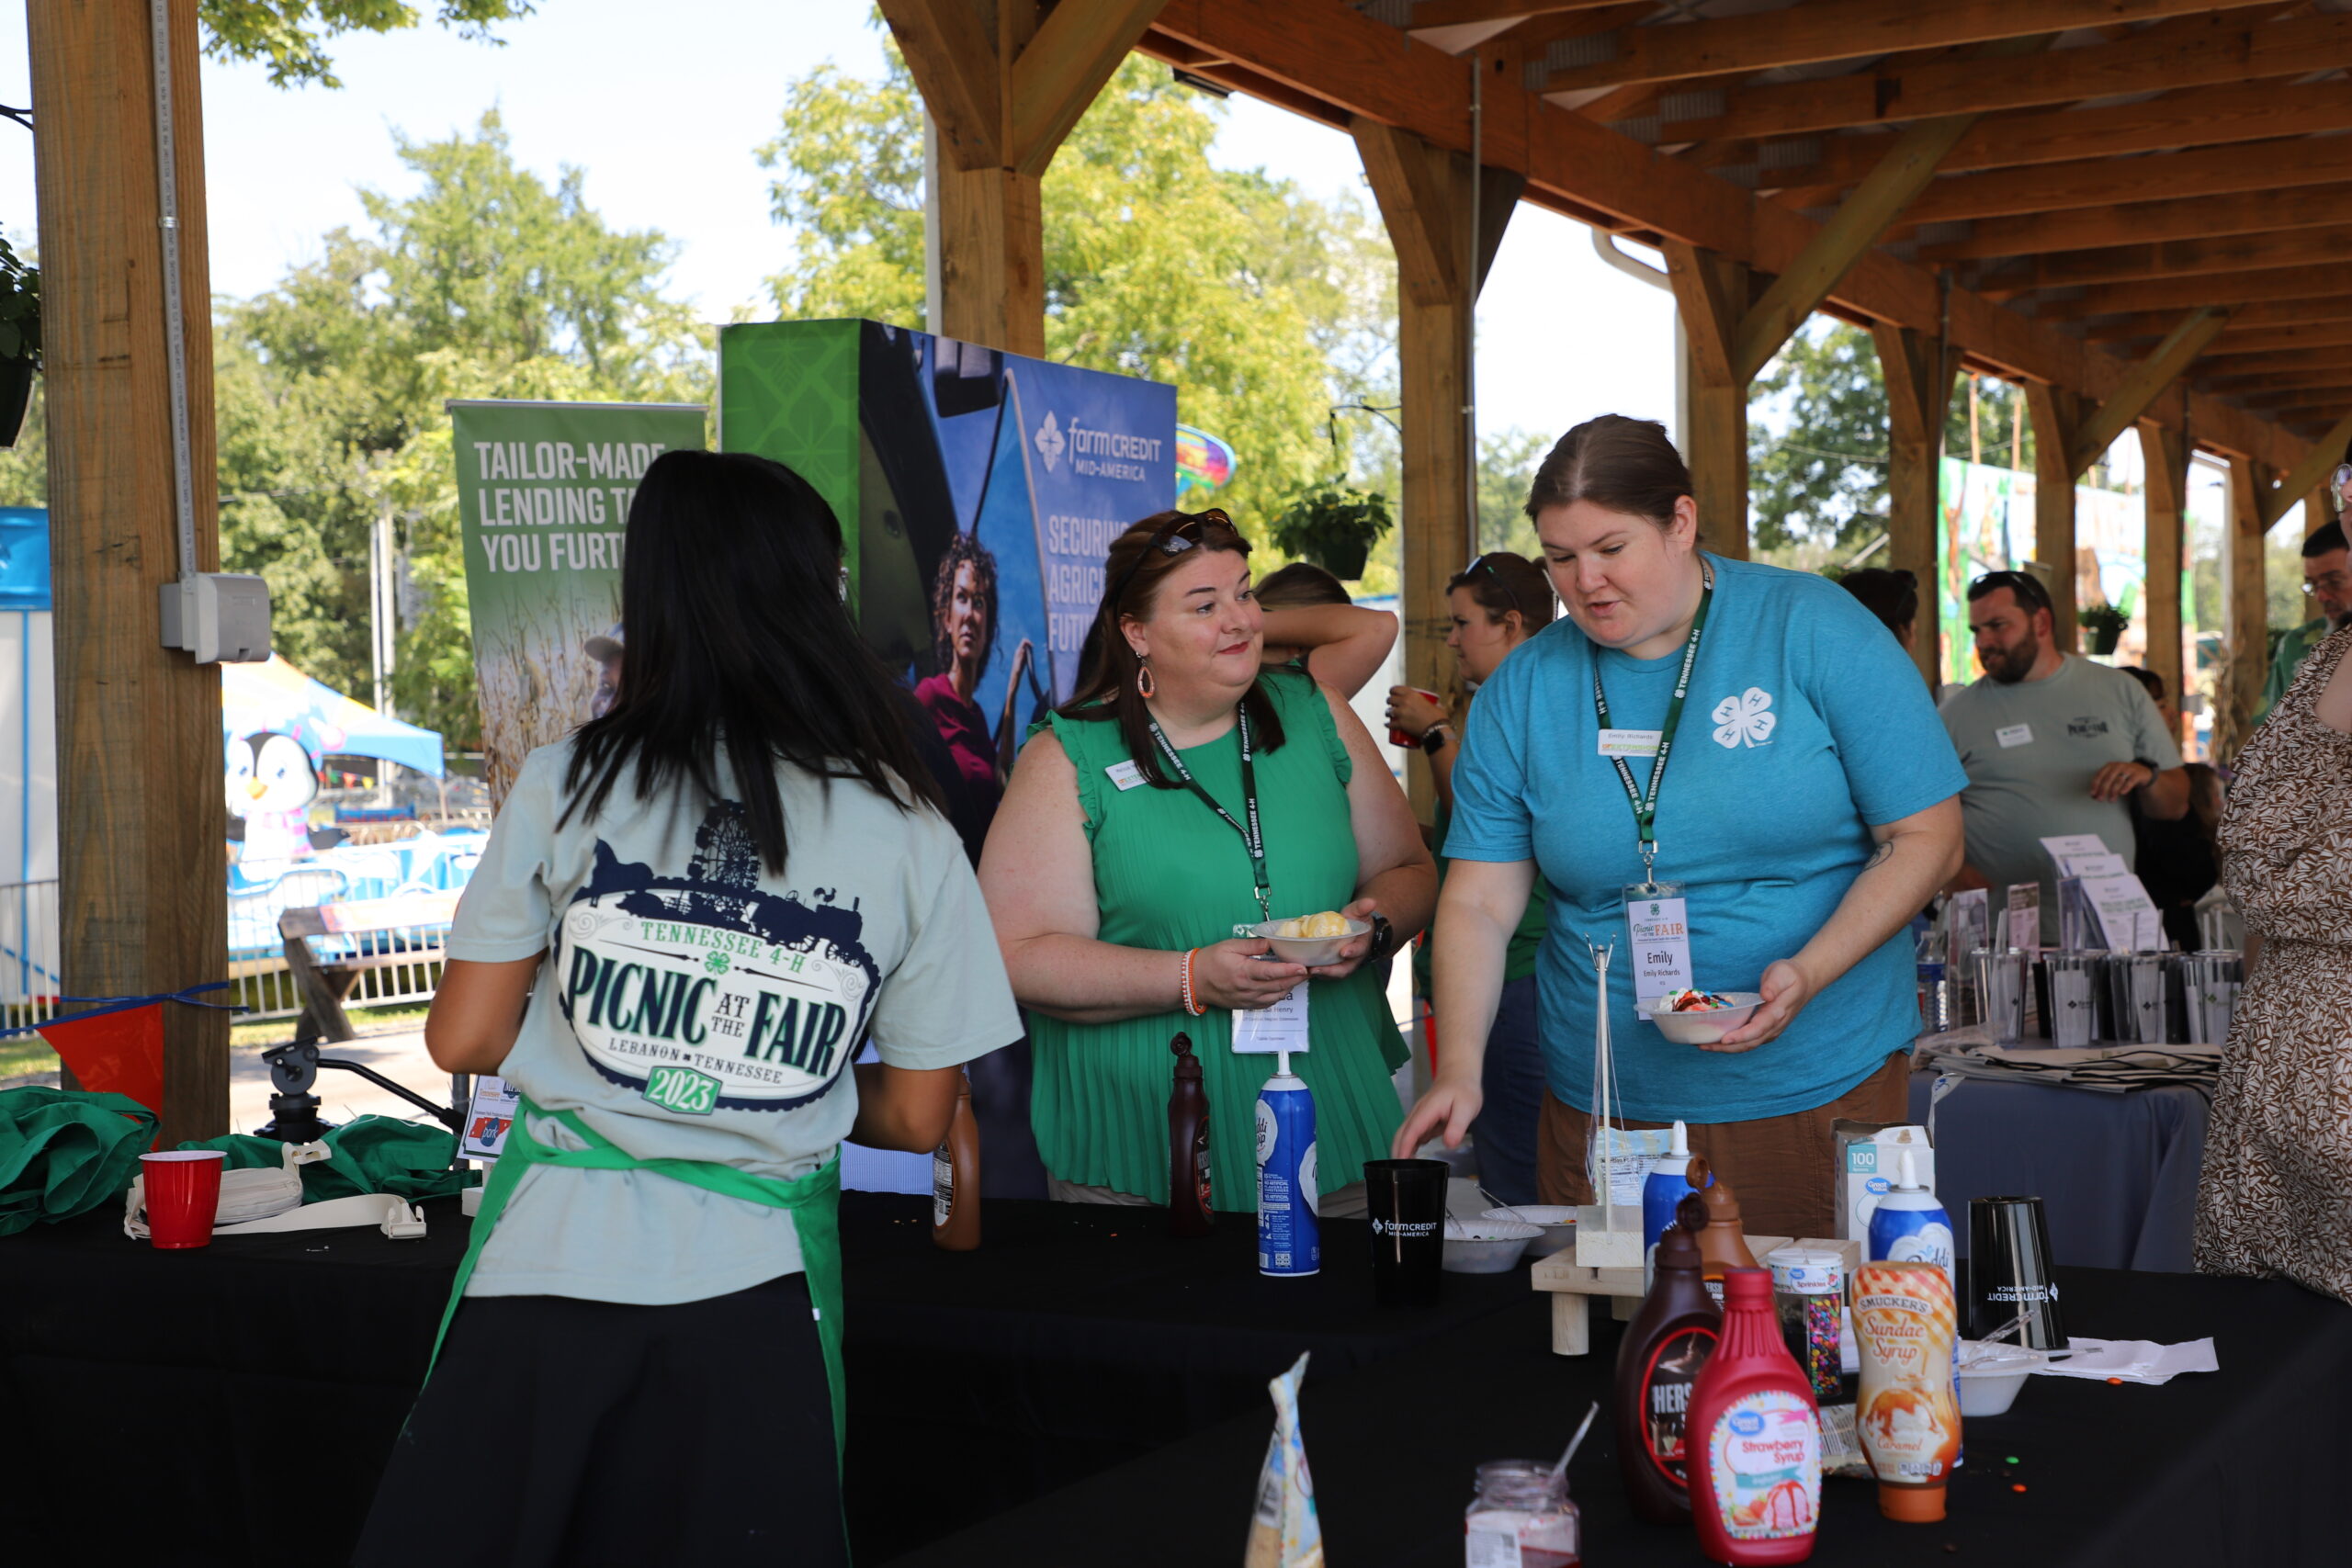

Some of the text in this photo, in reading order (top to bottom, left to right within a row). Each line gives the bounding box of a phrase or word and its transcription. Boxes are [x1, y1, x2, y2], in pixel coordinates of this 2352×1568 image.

[1076, 459, 1146, 481] MID-AMERICA
[479, 487, 606, 526] LENDING
[480, 532, 626, 572] YOU FURT
[1048, 613, 1094, 652] FUTU
[1679, 628, 1701, 689] TENNESSEE 4-H
[1598, 701, 1607, 715] 4-H
[1720, 706, 1734, 717] H
[1748, 694, 1762, 706] H
[1240, 715, 1250, 753] TENNESSEE
[1722, 728, 1736, 741] H
[1753, 719, 1768, 730] H
[1154, 731, 1192, 780] TENNESSEE 4-H
[1647, 742, 1670, 801] TENNESSEE 4-H
[1615, 760, 1644, 815] TENNESSEE 4-H
[1250, 810, 1262, 849] TENNESSEE
[1655, 922, 1684, 936] FAIR
[640, 920, 805, 975] TENNESSEE 4-H
[1647, 951, 1673, 965] Emily
[569, 945, 846, 1077] PICNIC FAIR
[717, 993, 751, 1019] AT
[711, 1016, 745, 1039] THE
[609, 1038, 784, 1084] LEBANON TENNESSEE
[649, 1071, 717, 1111] 2023
[481, 1127, 499, 1140] pork
[1851, 1153, 1874, 1165] 100
[1860, 1296, 1928, 1314] SMUCKER'S
[1865, 1315, 1925, 1337] Sundae
[1872, 1337, 1918, 1366] Syrup
[1742, 1439, 1804, 1454] Strawberry
[1877, 1436, 1923, 1451] Caramel
[1773, 1452, 1805, 1465] Syrup
